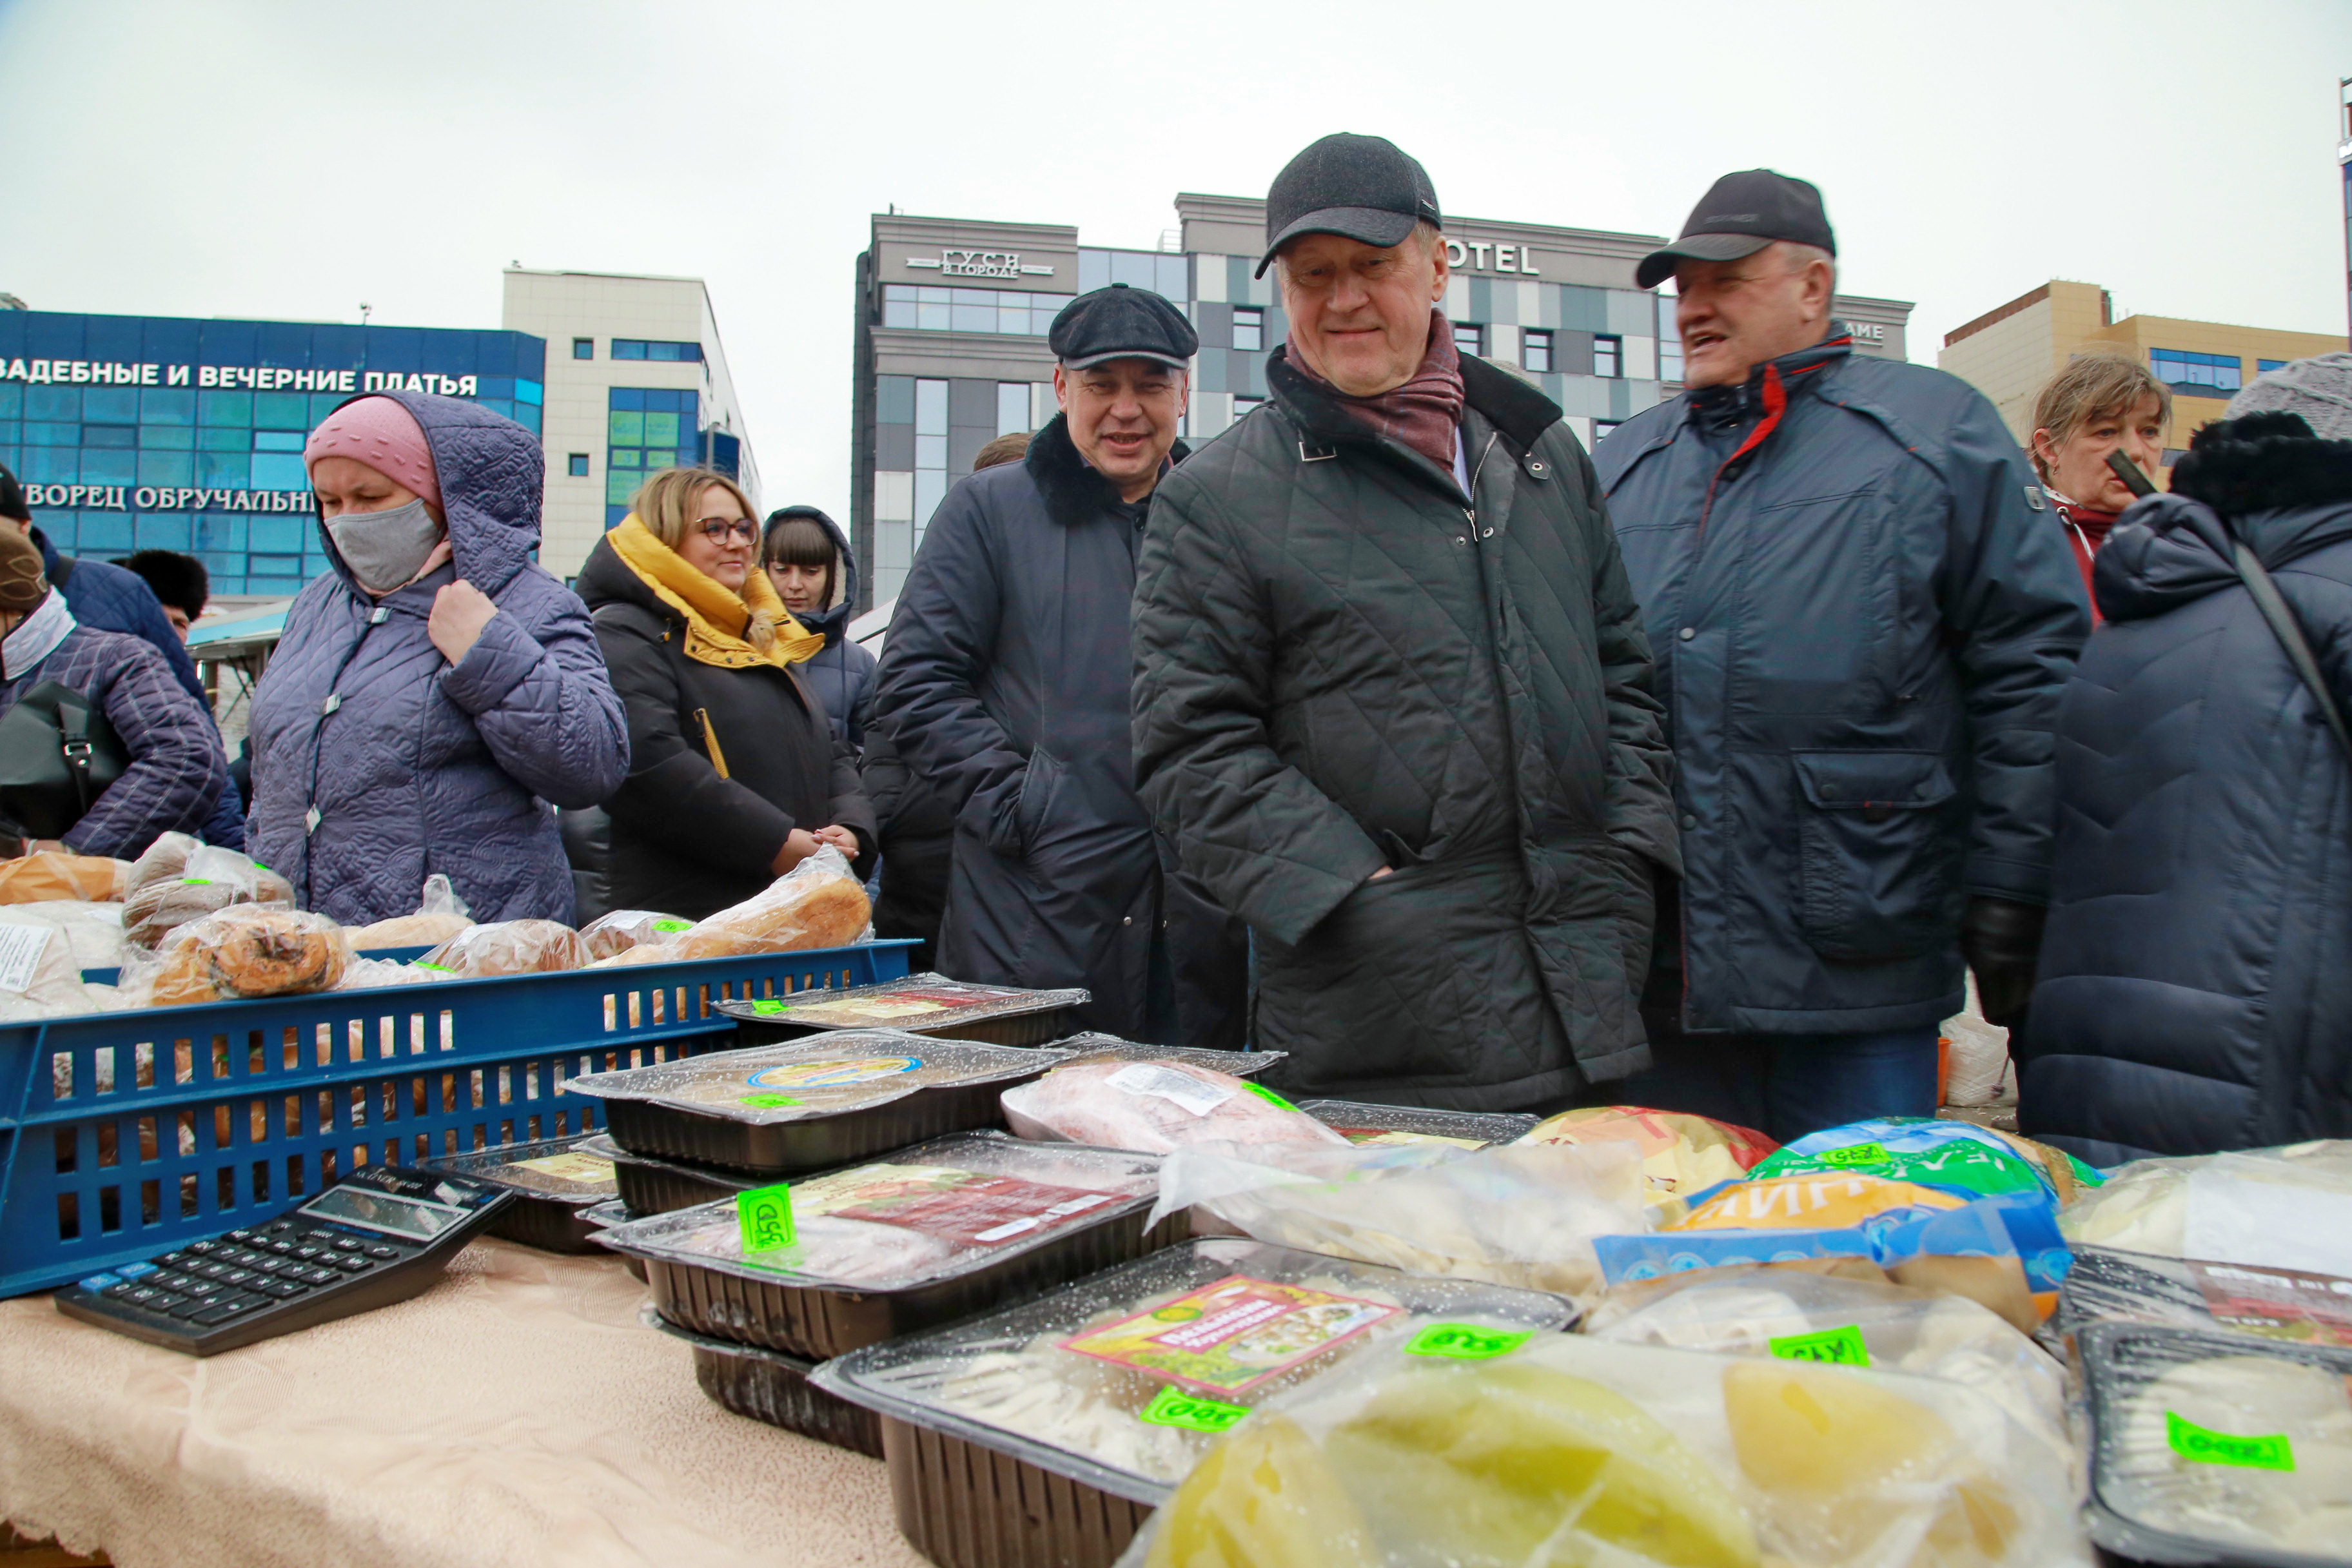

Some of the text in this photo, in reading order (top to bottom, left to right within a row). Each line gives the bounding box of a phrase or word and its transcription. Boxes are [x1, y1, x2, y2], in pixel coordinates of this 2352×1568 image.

[942, 250, 1020, 268] ГУСИ
[1446, 239, 1540, 275] OTEL
[943, 263, 952, 274] В
[957, 264, 1019, 277] ГОРОДЕ
[1846, 323, 1883, 339] AME
[168, 364, 190, 386] И
[199, 366, 356, 392] ВЕЧЕРНИЕ
[364, 371, 478, 397] ПЛАТЬЯ
[19, 484, 315, 513] ВОРЕЦ ОБРУЧАЛЬН
